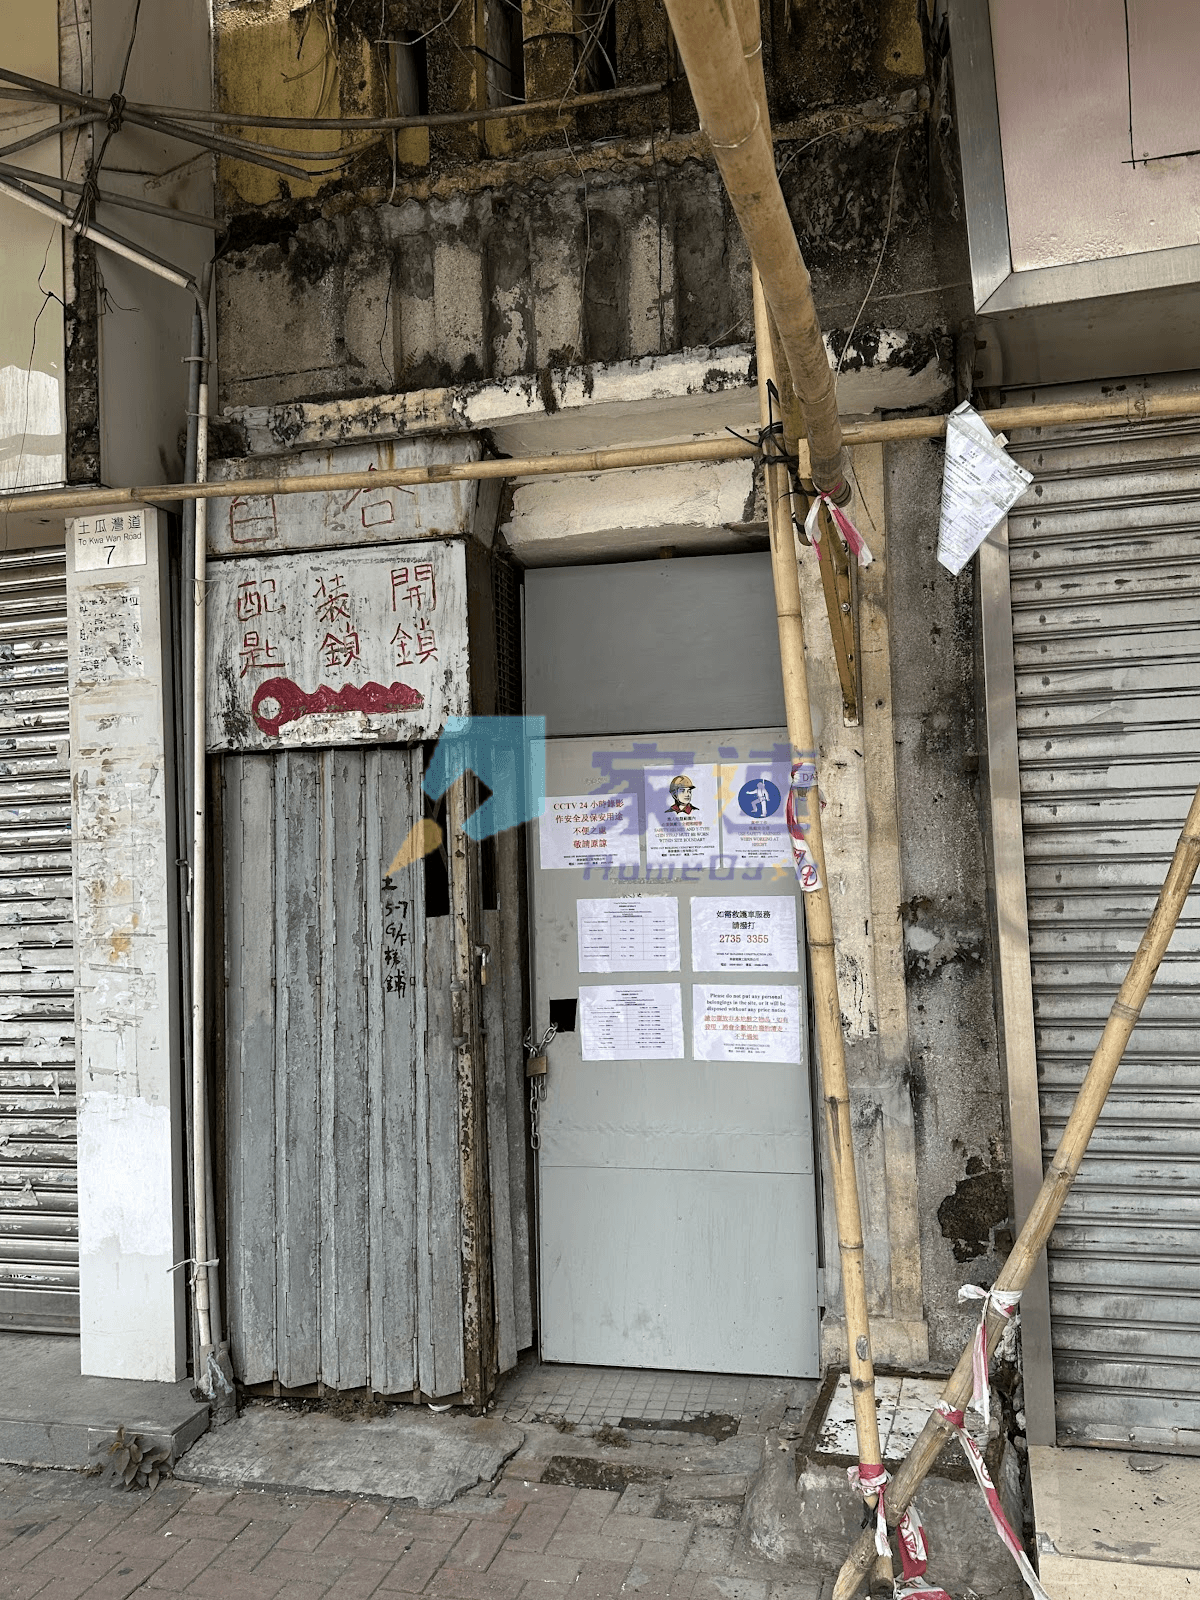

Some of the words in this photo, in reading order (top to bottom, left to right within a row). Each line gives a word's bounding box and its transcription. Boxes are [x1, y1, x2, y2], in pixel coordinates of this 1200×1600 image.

[78, 515, 141, 535] 土瓜灣道
[78, 538, 87, 546] To
[89, 537, 104, 545] Kwa
[105, 534, 122, 543] Wan
[123, 532, 142, 541] Road
[103, 545, 116, 565] 7
[389, 563, 440, 668] 開鎖
[237, 578, 287, 679] 配匙
[590, 799, 624, 809] 小時錄影
[555, 812, 624, 823] 作安全及保安用途
[573, 826, 607, 835] 不便之處
[385, 900, 408, 918] 5-7
[716, 910, 771, 919] 如需救護車服務
[732, 921, 755, 930] 請撥打
[385, 922, 407, 947] G/F
[719, 934, 741, 943] 2735
[746, 934, 769, 943] 3355
